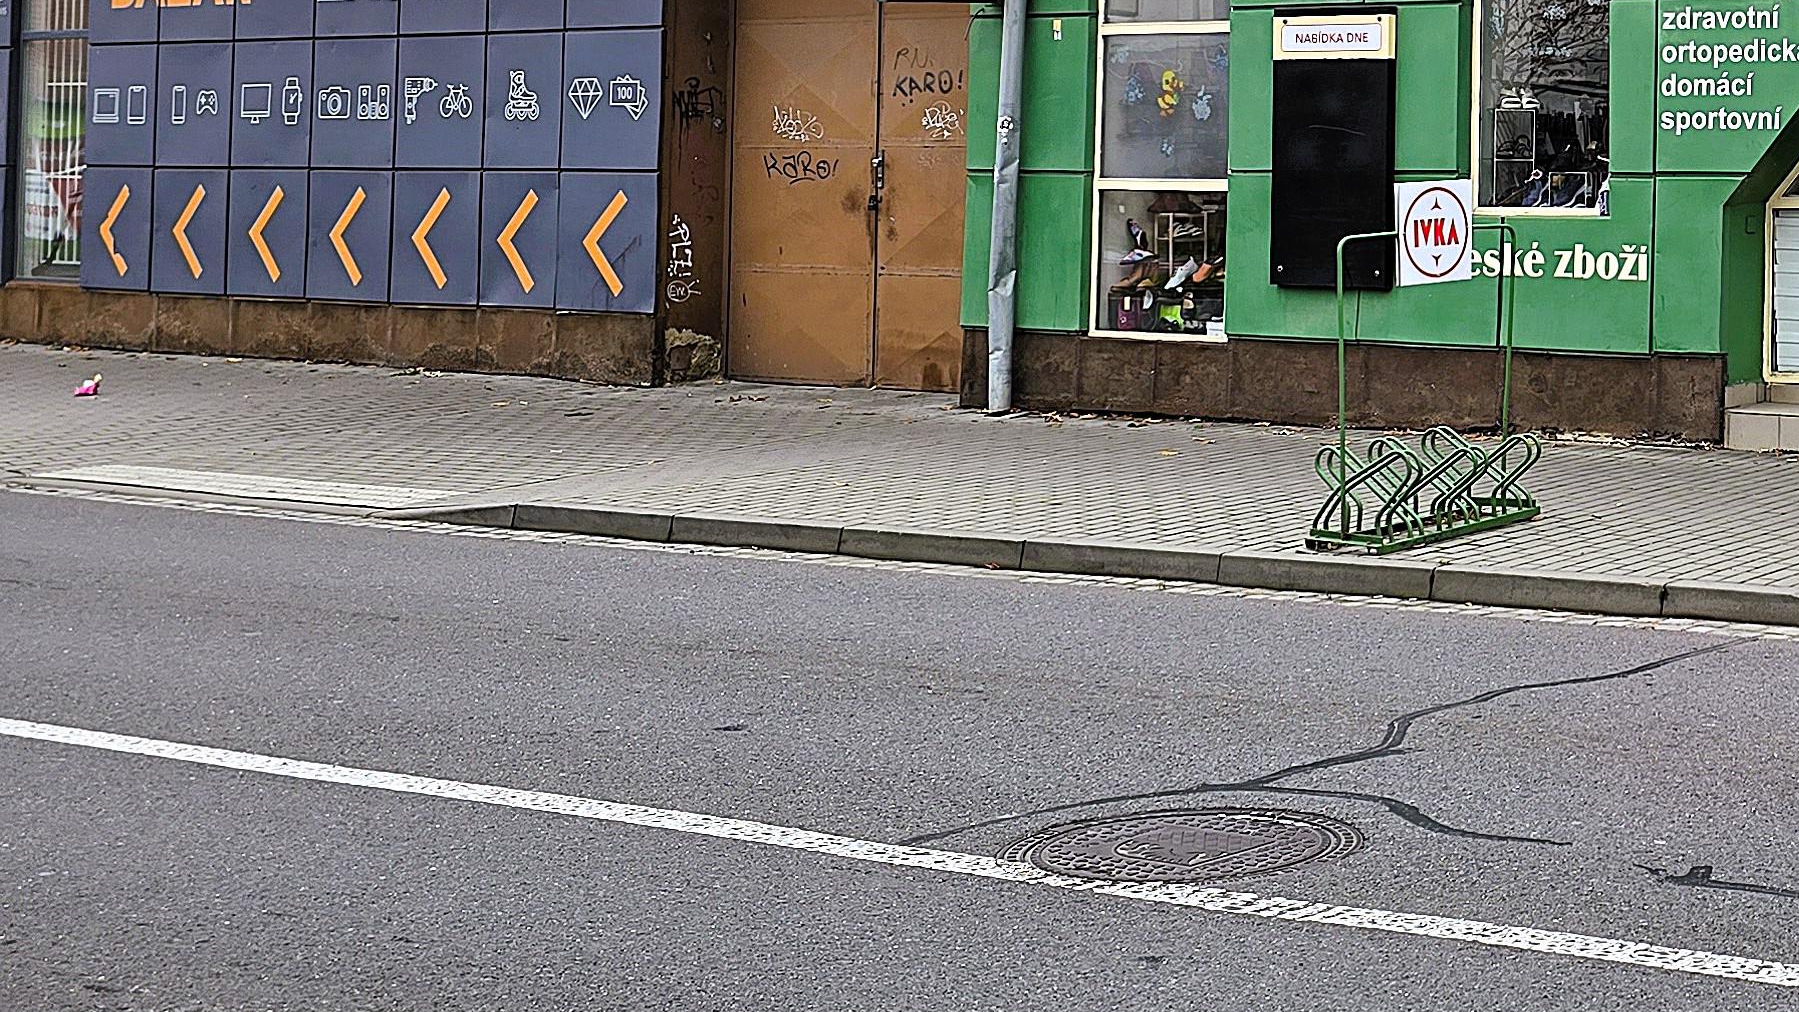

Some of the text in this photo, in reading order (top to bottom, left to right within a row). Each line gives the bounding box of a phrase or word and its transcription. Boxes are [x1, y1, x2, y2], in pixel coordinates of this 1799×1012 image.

[1662, 4, 1780, 30] zdravotní
[1295, 31, 1369, 44] NABÍDKA DNE
[616, 86, 633, 100] 100
[1661, 72, 1755, 97] domácí
[1660, 106, 1783, 136] sportovní
[1413, 218, 1460, 248] IVKA
[1471, 241, 1648, 281] eské zboží
